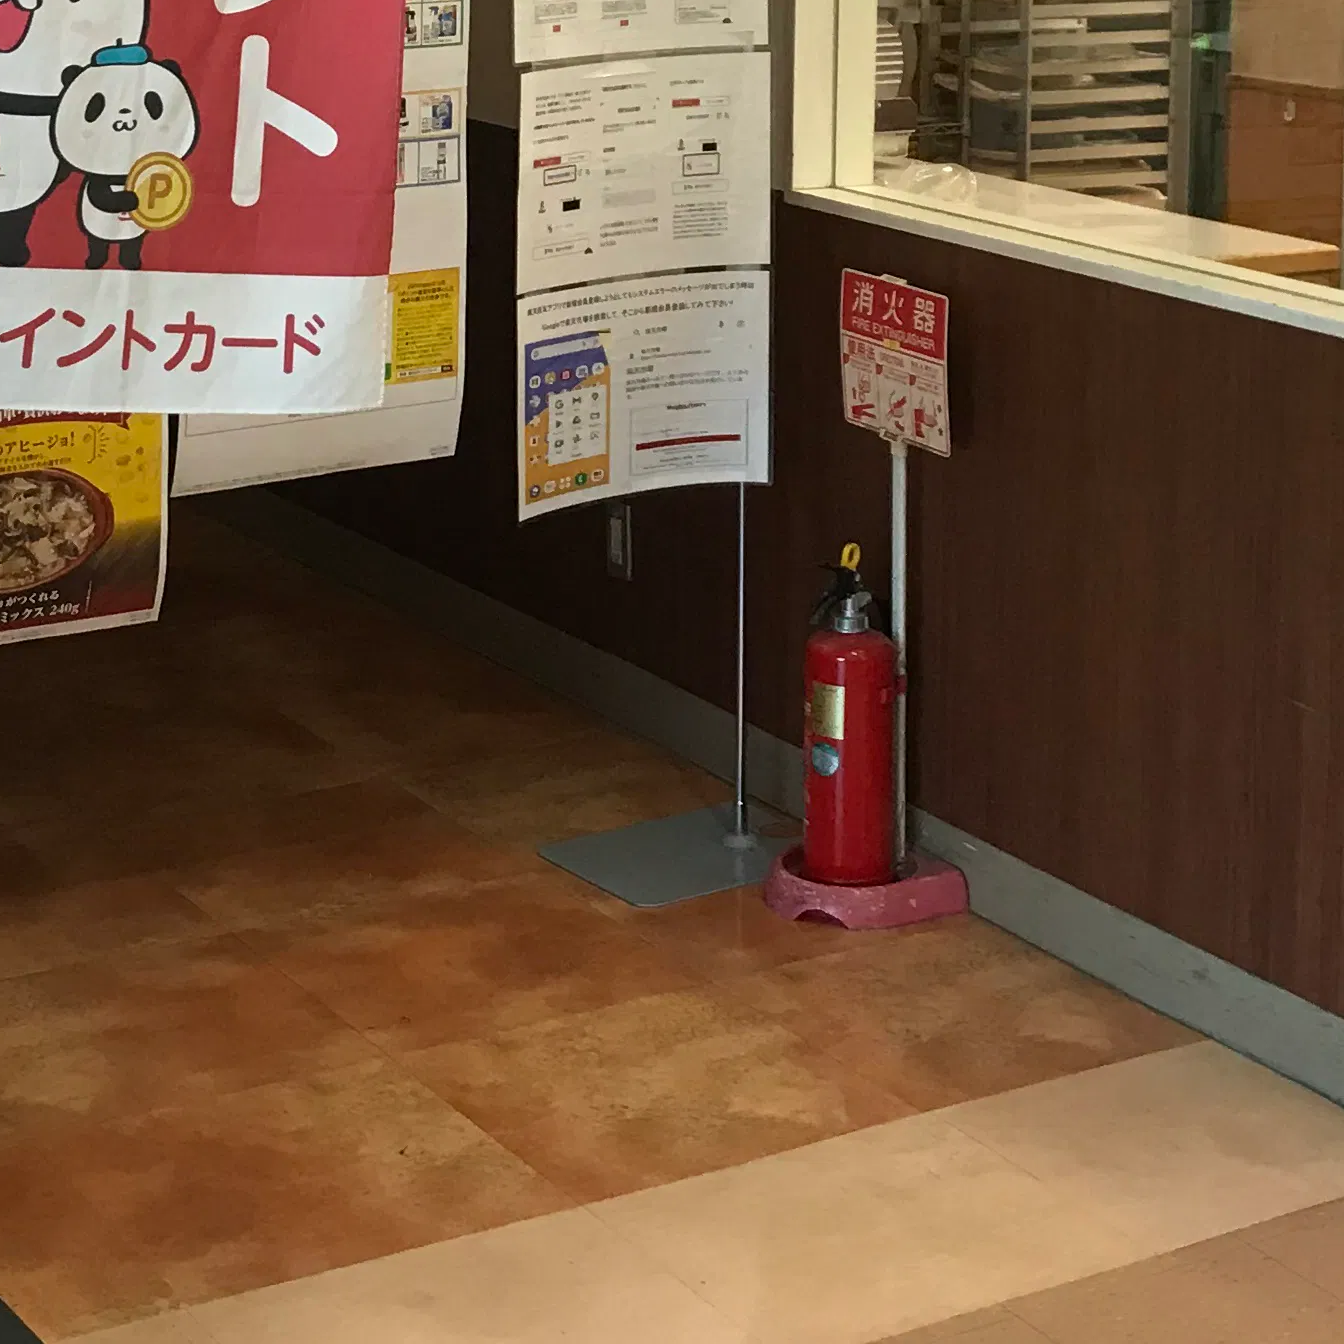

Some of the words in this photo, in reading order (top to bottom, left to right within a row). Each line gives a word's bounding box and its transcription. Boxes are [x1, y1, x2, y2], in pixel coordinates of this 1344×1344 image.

[146, 172, 173, 210] P
[852, 281, 936, 334] 消火器
[49, 602, 80, 618] 240g
